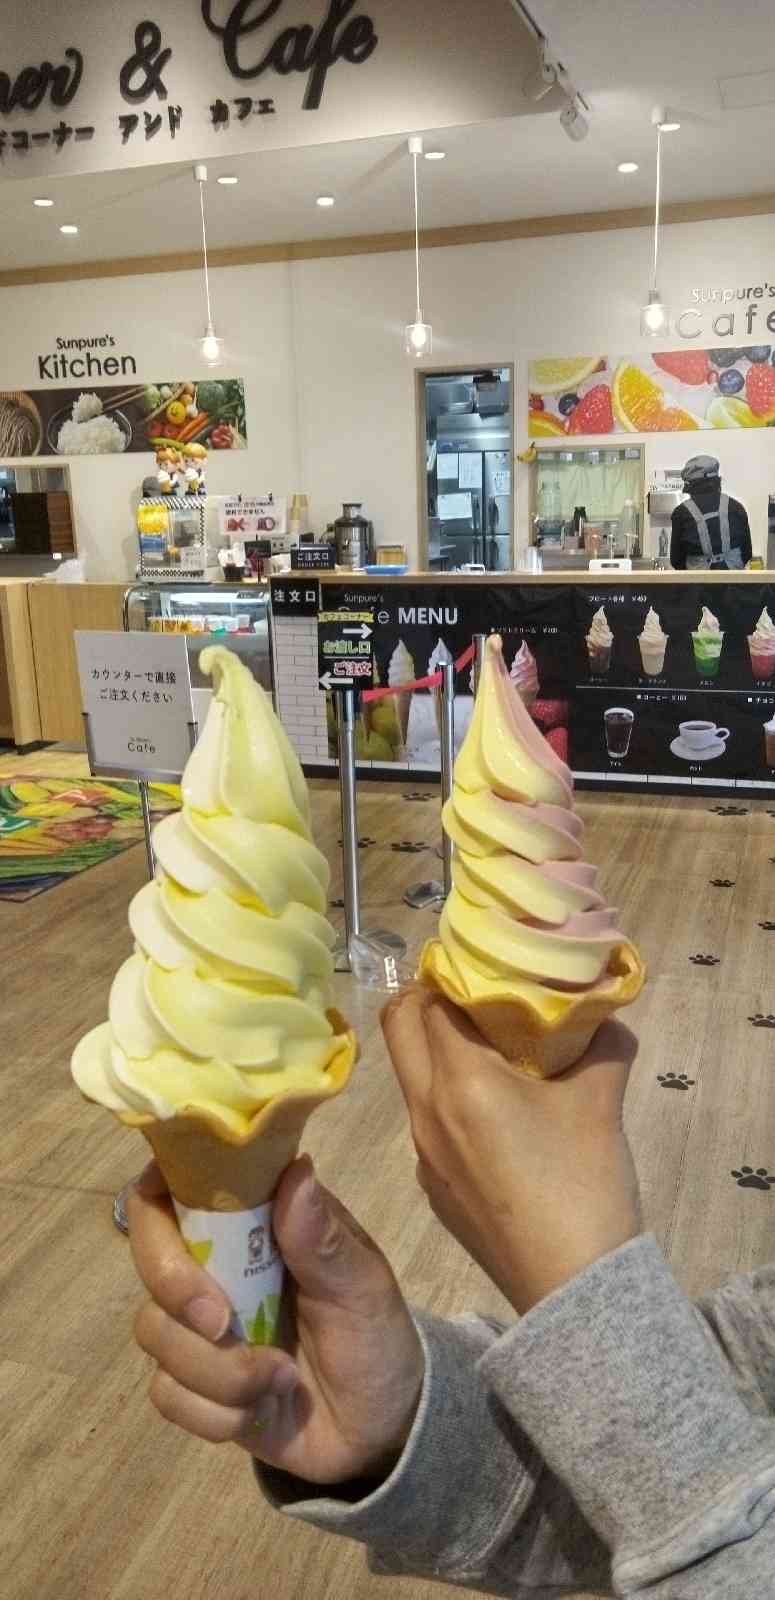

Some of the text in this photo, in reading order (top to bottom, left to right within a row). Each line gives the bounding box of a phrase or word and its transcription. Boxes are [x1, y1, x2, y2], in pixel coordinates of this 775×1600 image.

[119, 20, 172, 104] &
[201, 0, 378, 110] Cafe
[118, 104, 182, 145] アンド
[209, 98, 276, 129] カフェ
[56, 334, 116, 350] Sunpure's
[38, 352, 137, 379] Kitchen
[274, 589, 317, 603] 注文口
[344, 592, 384, 604] Sunpure's
[398, 607, 459, 625] MENU
[91, 668, 176, 684] カウンターで直接
[100, 688, 174, 703] ご注文ください
[127, 742, 157, 754] Cafe
